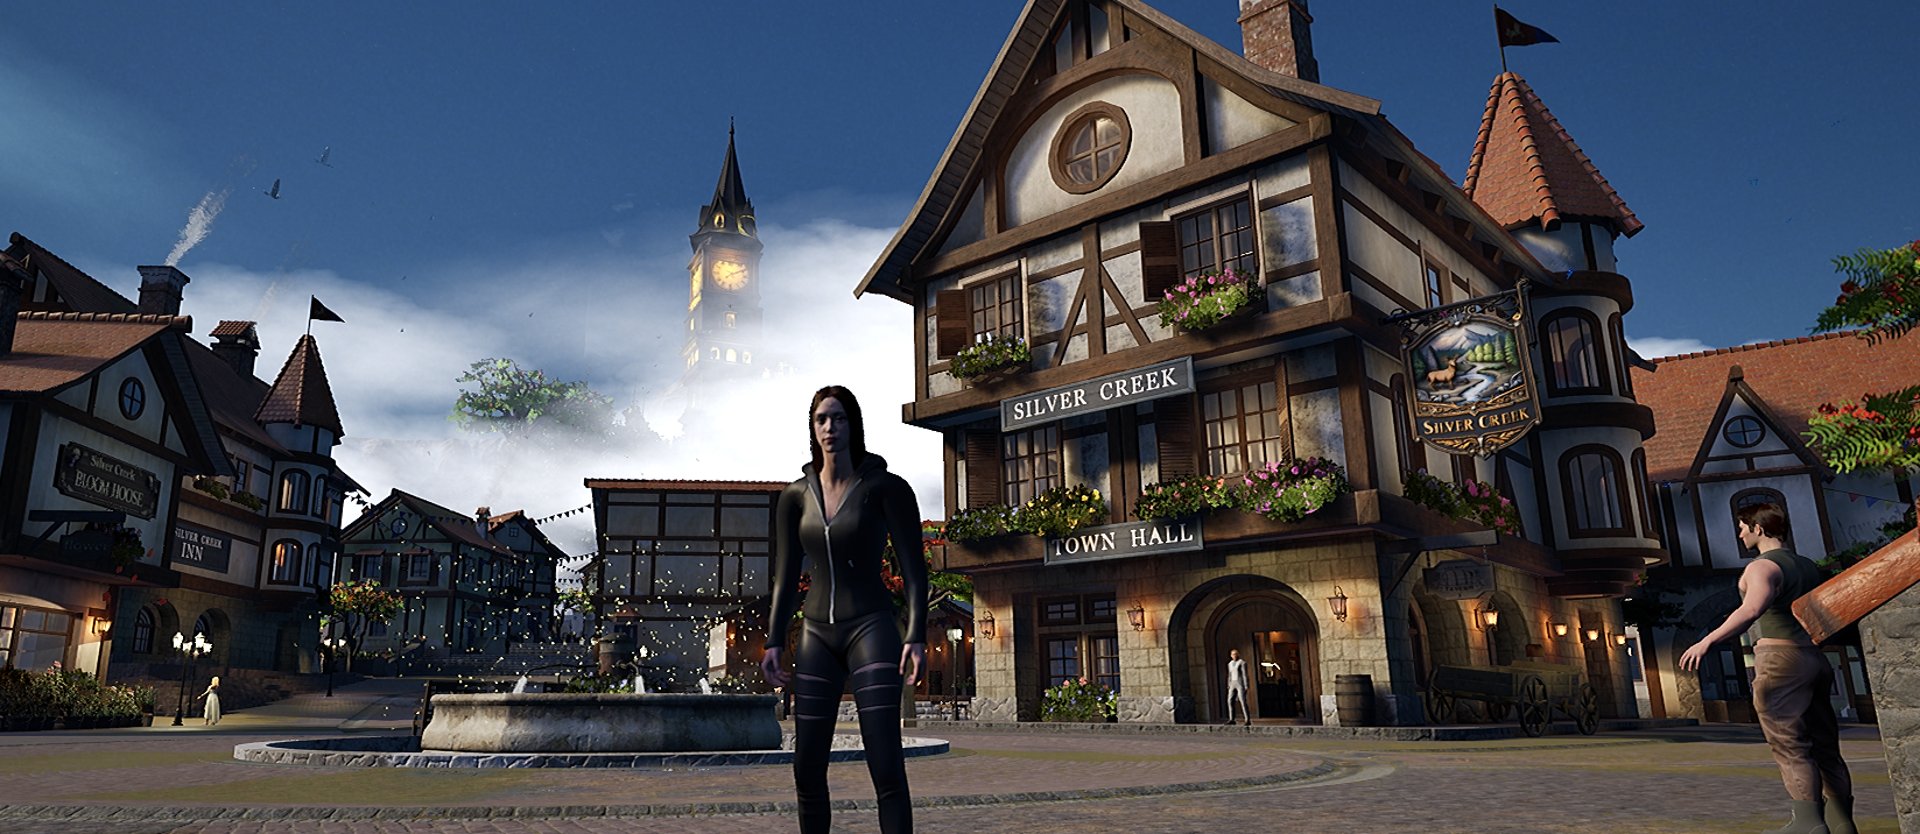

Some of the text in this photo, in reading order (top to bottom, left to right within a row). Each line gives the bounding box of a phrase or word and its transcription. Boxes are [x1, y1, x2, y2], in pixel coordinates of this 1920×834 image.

[1013, 367, 1178, 420] SILVER CREEK
[1422, 407, 1530, 436] SILVER CREEK
[74, 468, 110, 496] BLOOM
[90, 455, 137, 481] Silver Creek
[175, 527, 223, 549] SILVER CREEK
[181, 542, 204, 562] INN
[1052, 523, 1194, 556] TOWN HALL
